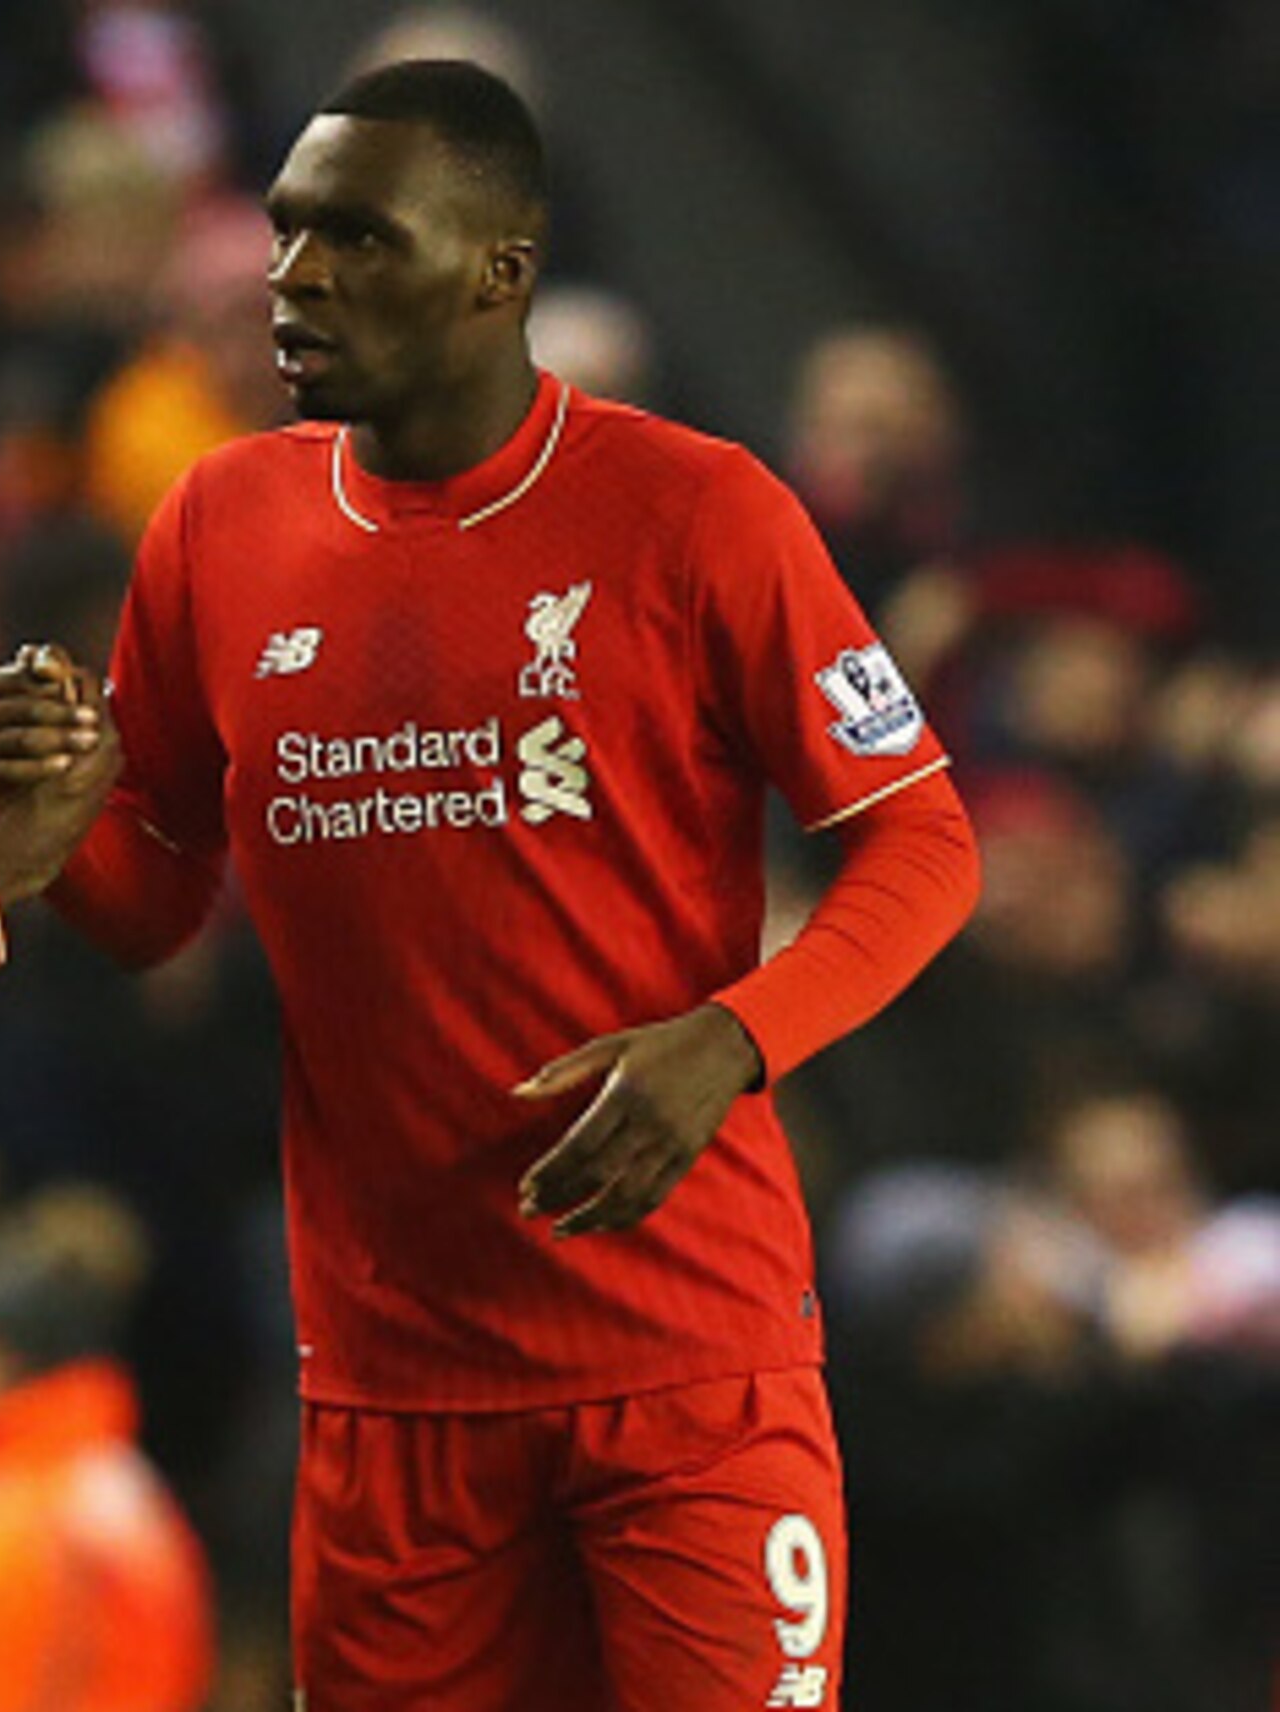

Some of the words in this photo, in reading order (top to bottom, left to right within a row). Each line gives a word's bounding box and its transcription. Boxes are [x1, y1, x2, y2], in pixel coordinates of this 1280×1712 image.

[277, 717, 500, 783] Standard
[267, 777, 508, 844] Chartered
[765, 1514, 826, 1658] 9
